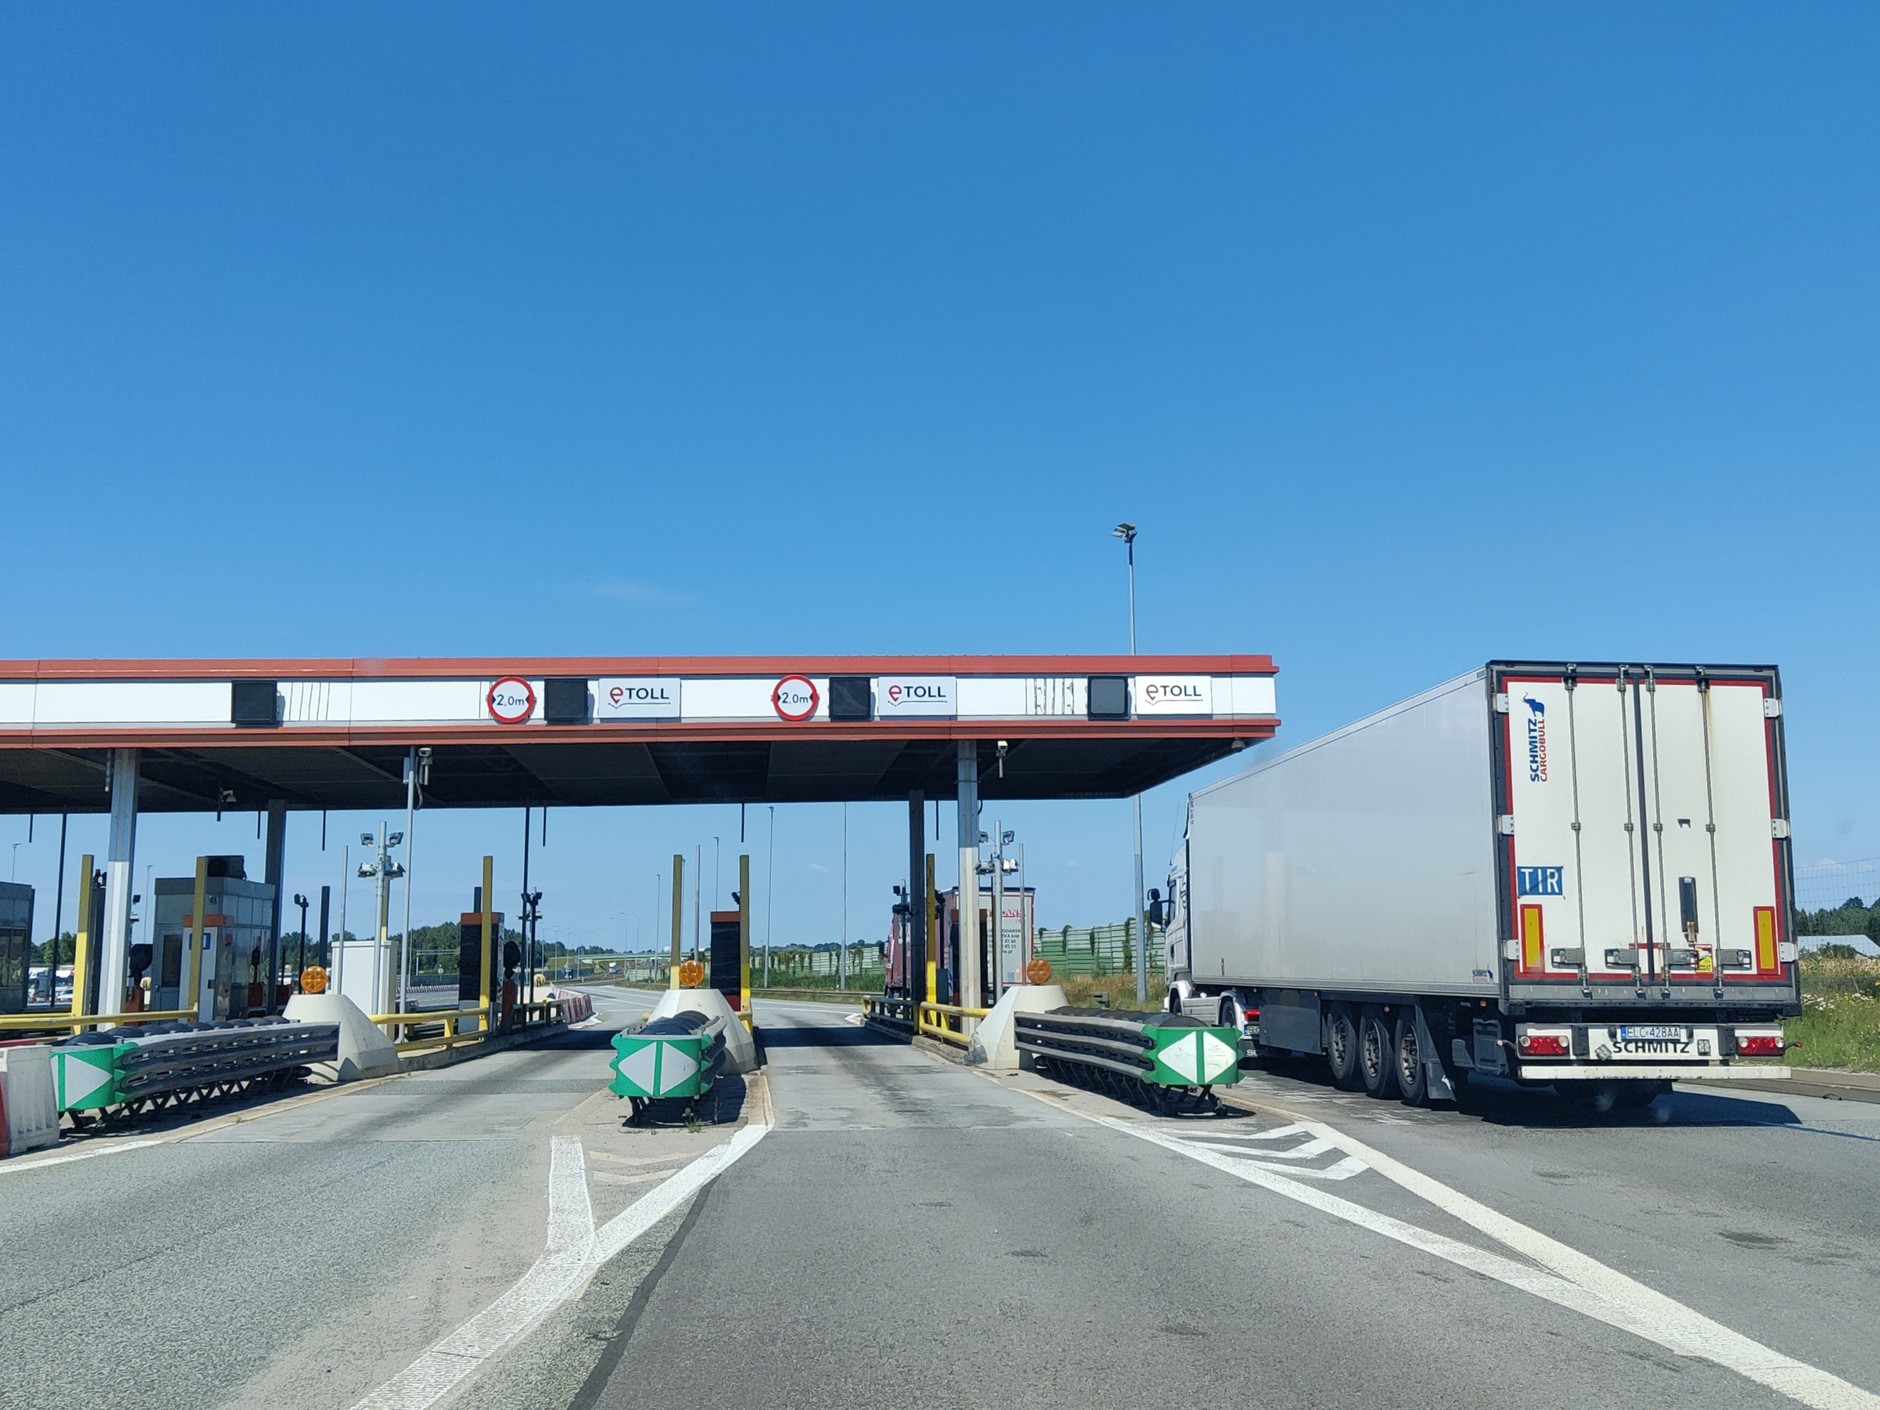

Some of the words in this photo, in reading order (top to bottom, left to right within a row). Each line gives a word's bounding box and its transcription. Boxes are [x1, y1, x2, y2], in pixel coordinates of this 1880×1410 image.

[496, 693, 525, 707] 2,0m
[609, 686, 670, 704] eTOLL
[781, 691, 809, 706] 2,0m
[888, 685, 946, 702] eTOLL
[1145, 684, 1202, 700] eTOLL
[1528, 717, 1540, 782] SCHMITZ
[1538, 718, 1548, 782] CARGOBULL
[1520, 868, 1560, 893] TIR
[1612, 1041, 1690, 1053] SCHMITZ
